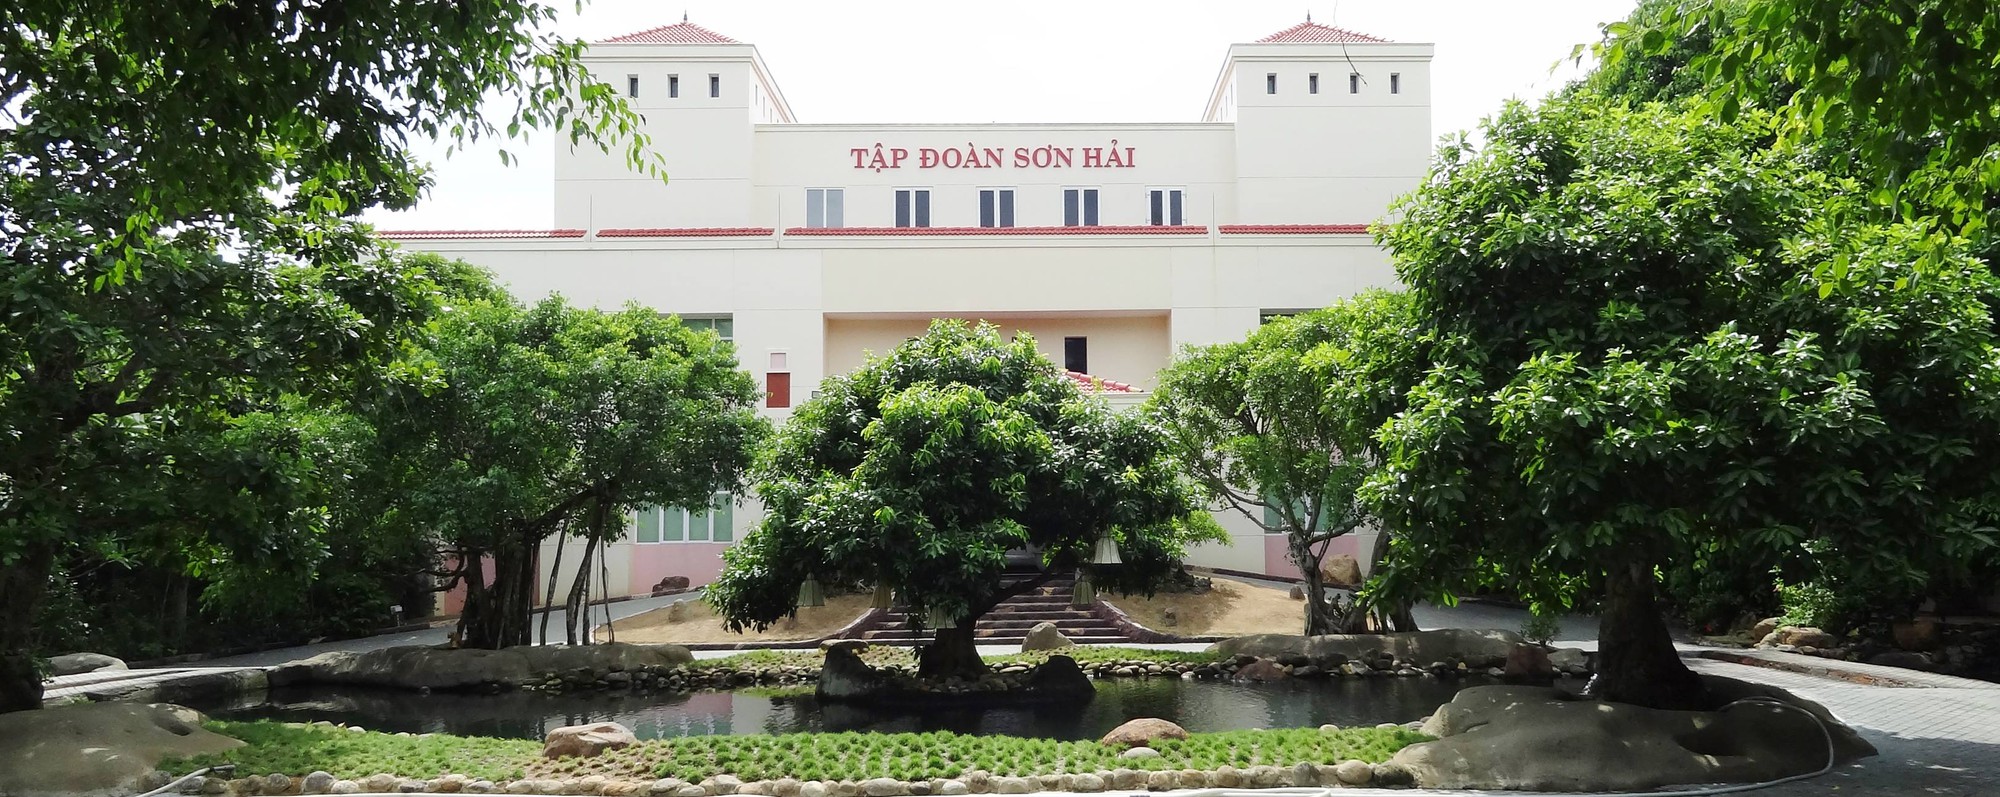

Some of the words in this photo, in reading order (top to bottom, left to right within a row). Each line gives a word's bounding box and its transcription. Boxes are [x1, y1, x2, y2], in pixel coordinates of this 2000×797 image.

[851, 143, 908, 173] TẬP
[919, 142, 1004, 169] ĐOÀN
[1014, 144, 1074, 168] SƠN
[1082, 139, 1136, 168] HẢI
